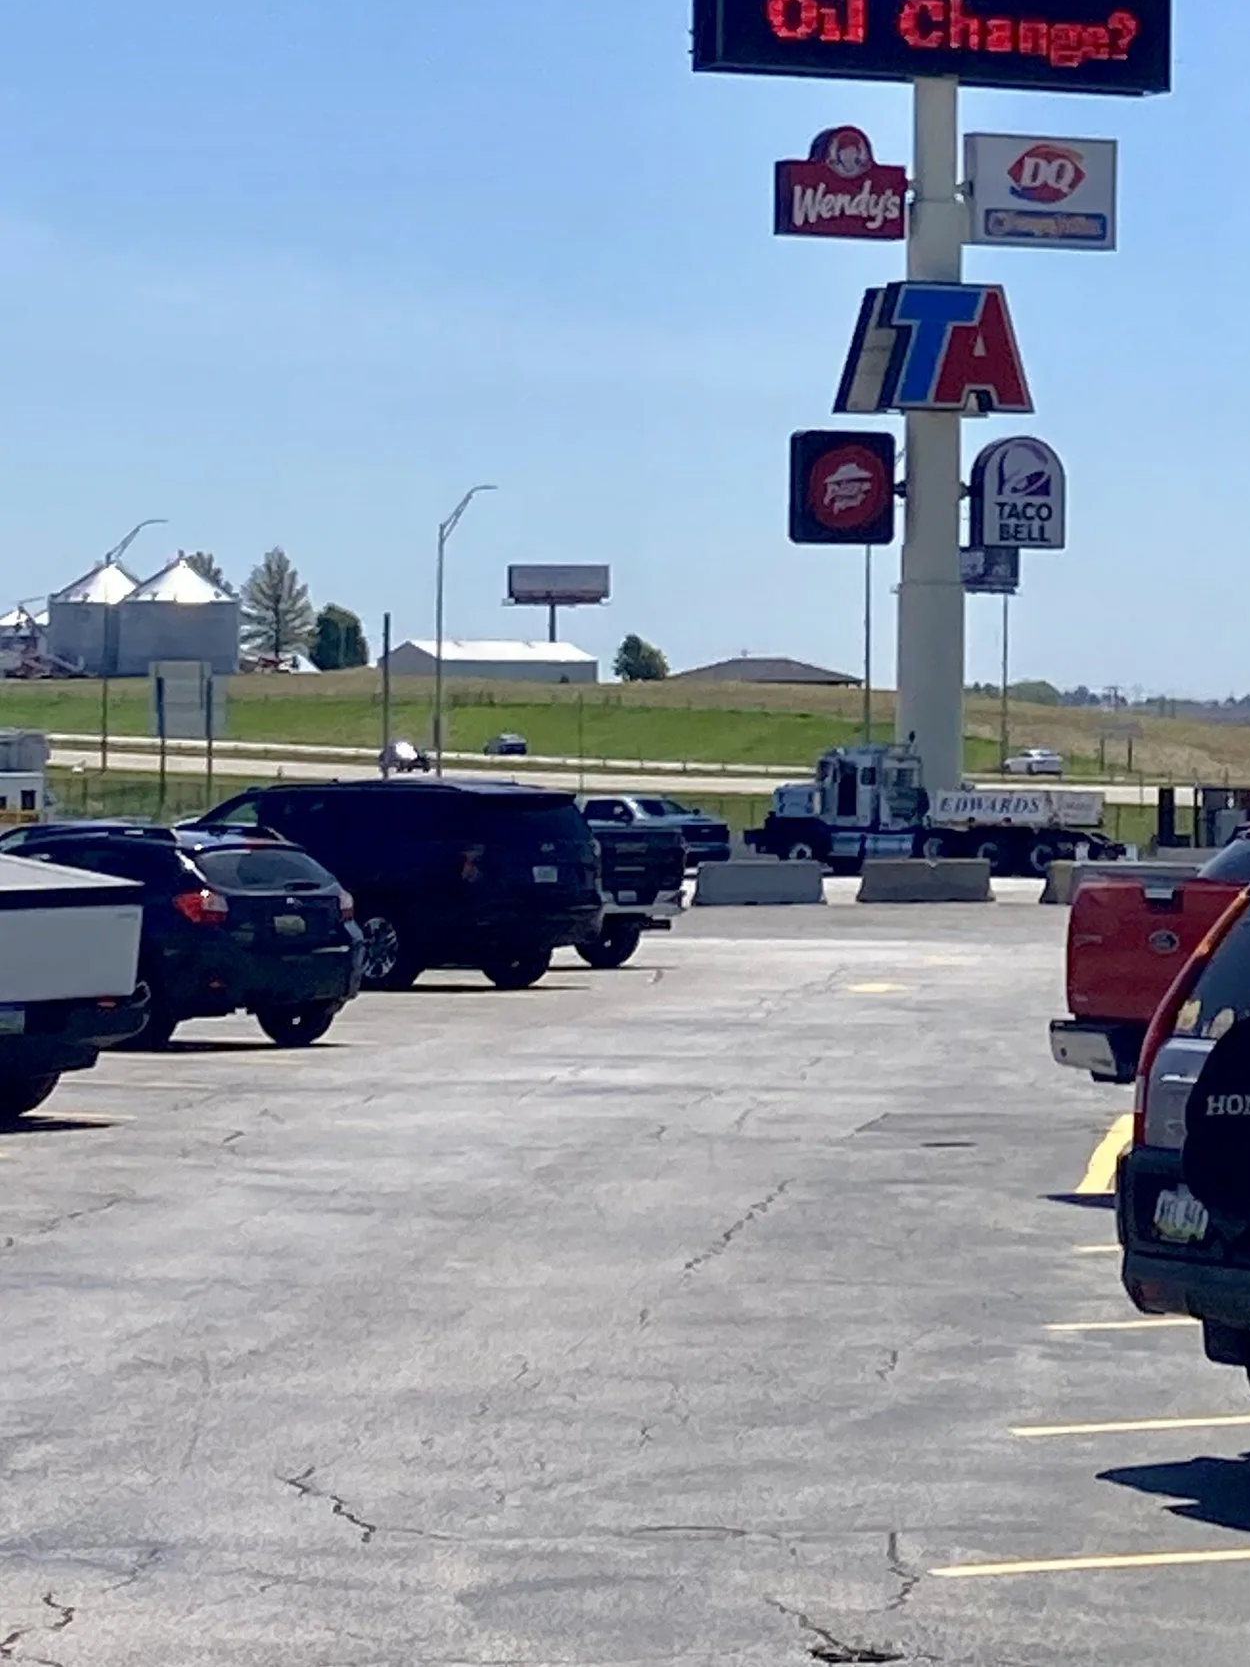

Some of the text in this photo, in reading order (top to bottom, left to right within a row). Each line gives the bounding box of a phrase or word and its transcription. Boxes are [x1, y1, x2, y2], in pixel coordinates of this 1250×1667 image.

[1020, 155, 1077, 194] DQ
[791, 180, 902, 230] Wendy's
[888, 282, 1035, 413] TA
[993, 501, 1053, 522] TACO
[999, 523, 1051, 542] BELL
[939, 796, 1040, 815] EDWARDS
